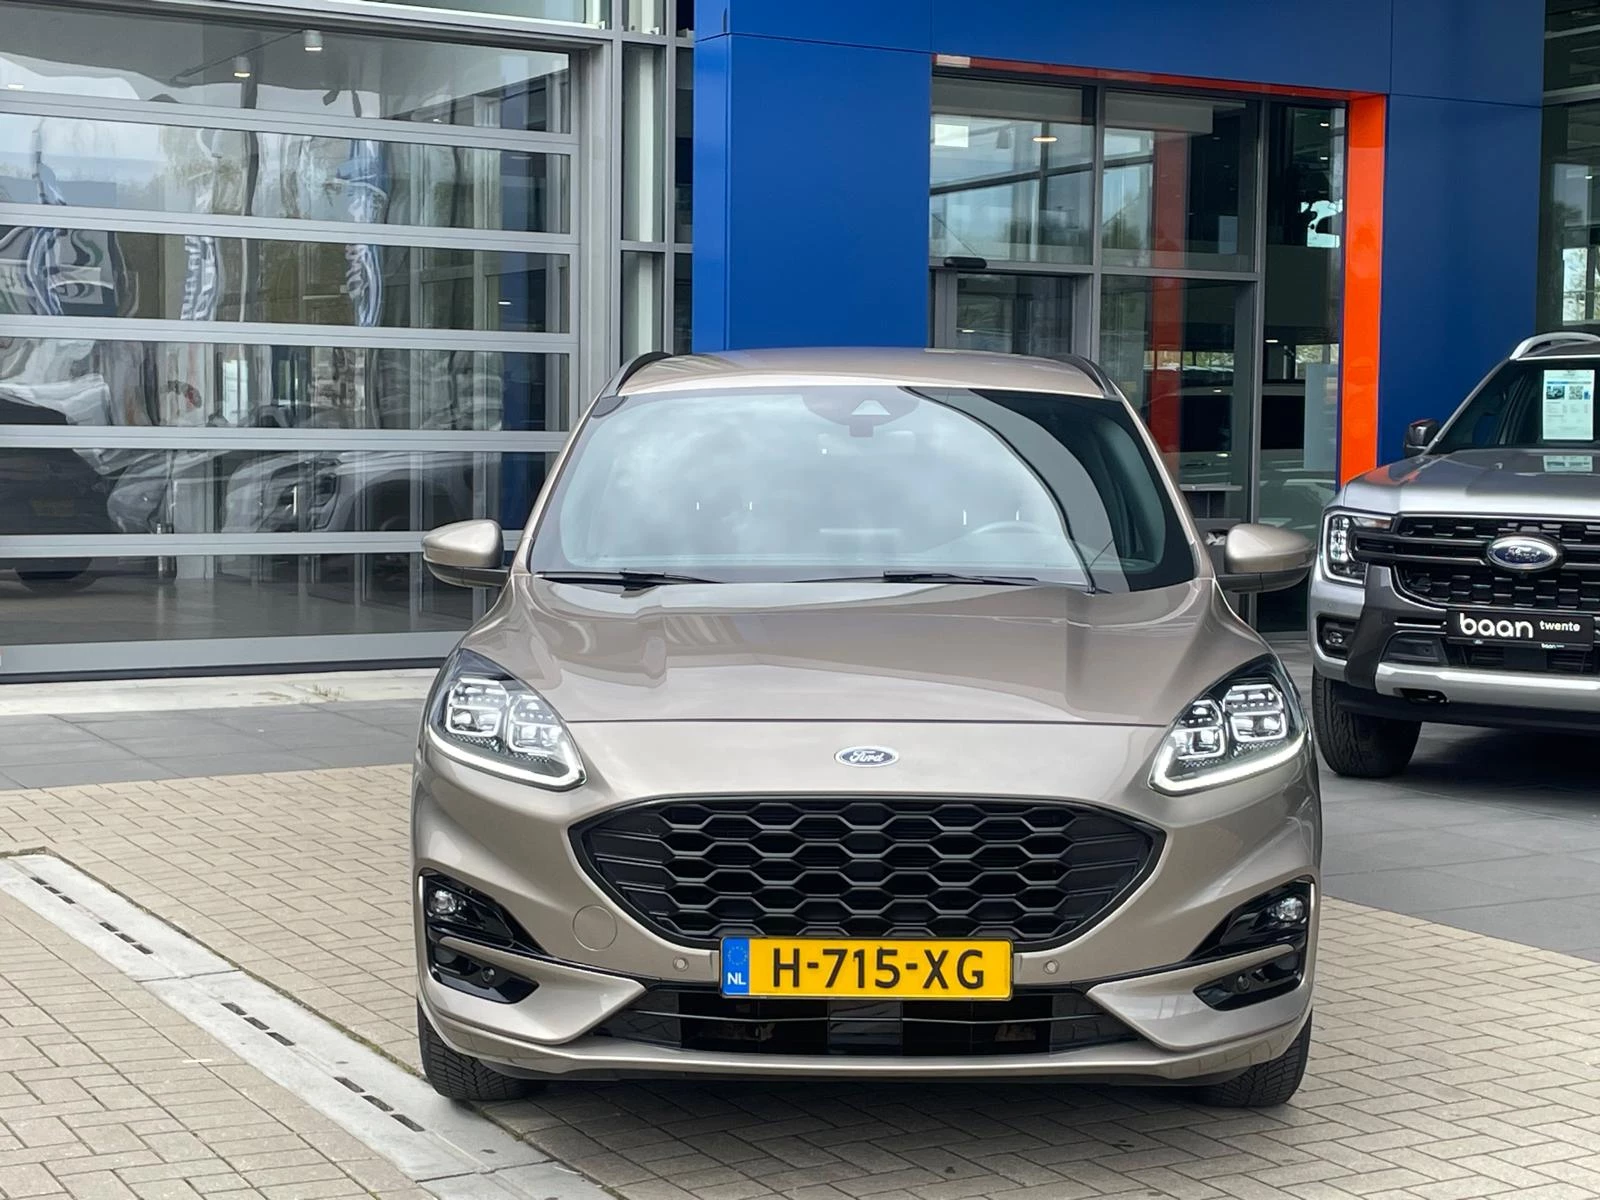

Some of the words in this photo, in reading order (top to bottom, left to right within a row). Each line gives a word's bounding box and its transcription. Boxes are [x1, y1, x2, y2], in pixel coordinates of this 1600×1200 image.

[1459, 613, 1534, 638] baan
[1539, 620, 1581, 632] twente
[849, 749, 885, 763] Ford
[773, 947, 985, 989] H-715-XG
[727, 972, 746, 985] NL
